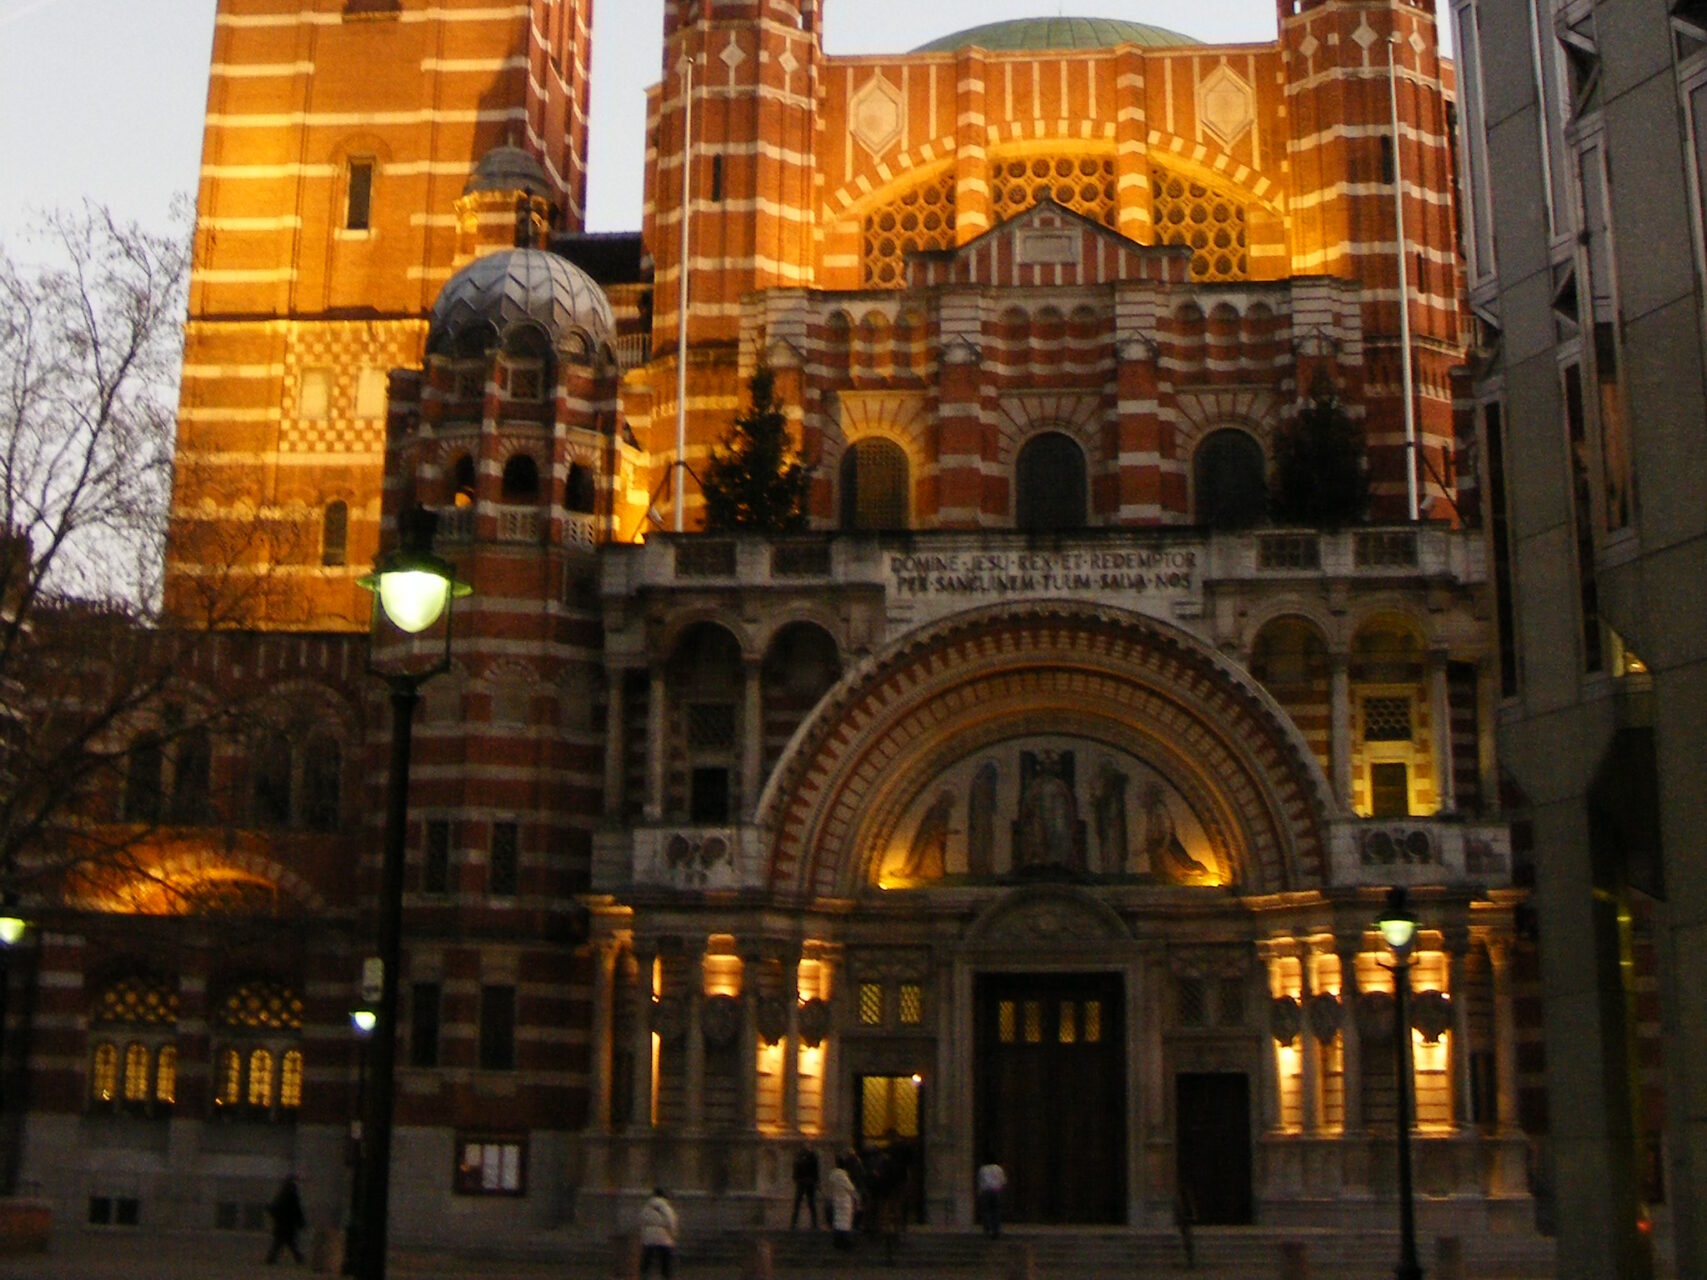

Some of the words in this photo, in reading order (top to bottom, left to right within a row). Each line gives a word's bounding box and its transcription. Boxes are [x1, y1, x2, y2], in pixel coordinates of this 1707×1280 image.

[891, 556, 958, 573] DOMINE
[967, 554, 1009, 572] JESU
[1018, 554, 1052, 572] REX
[1060, 553, 1081, 570] ET
[1091, 552, 1196, 570] REDEMPTOR
[1155, 572, 1190, 590] NOS
